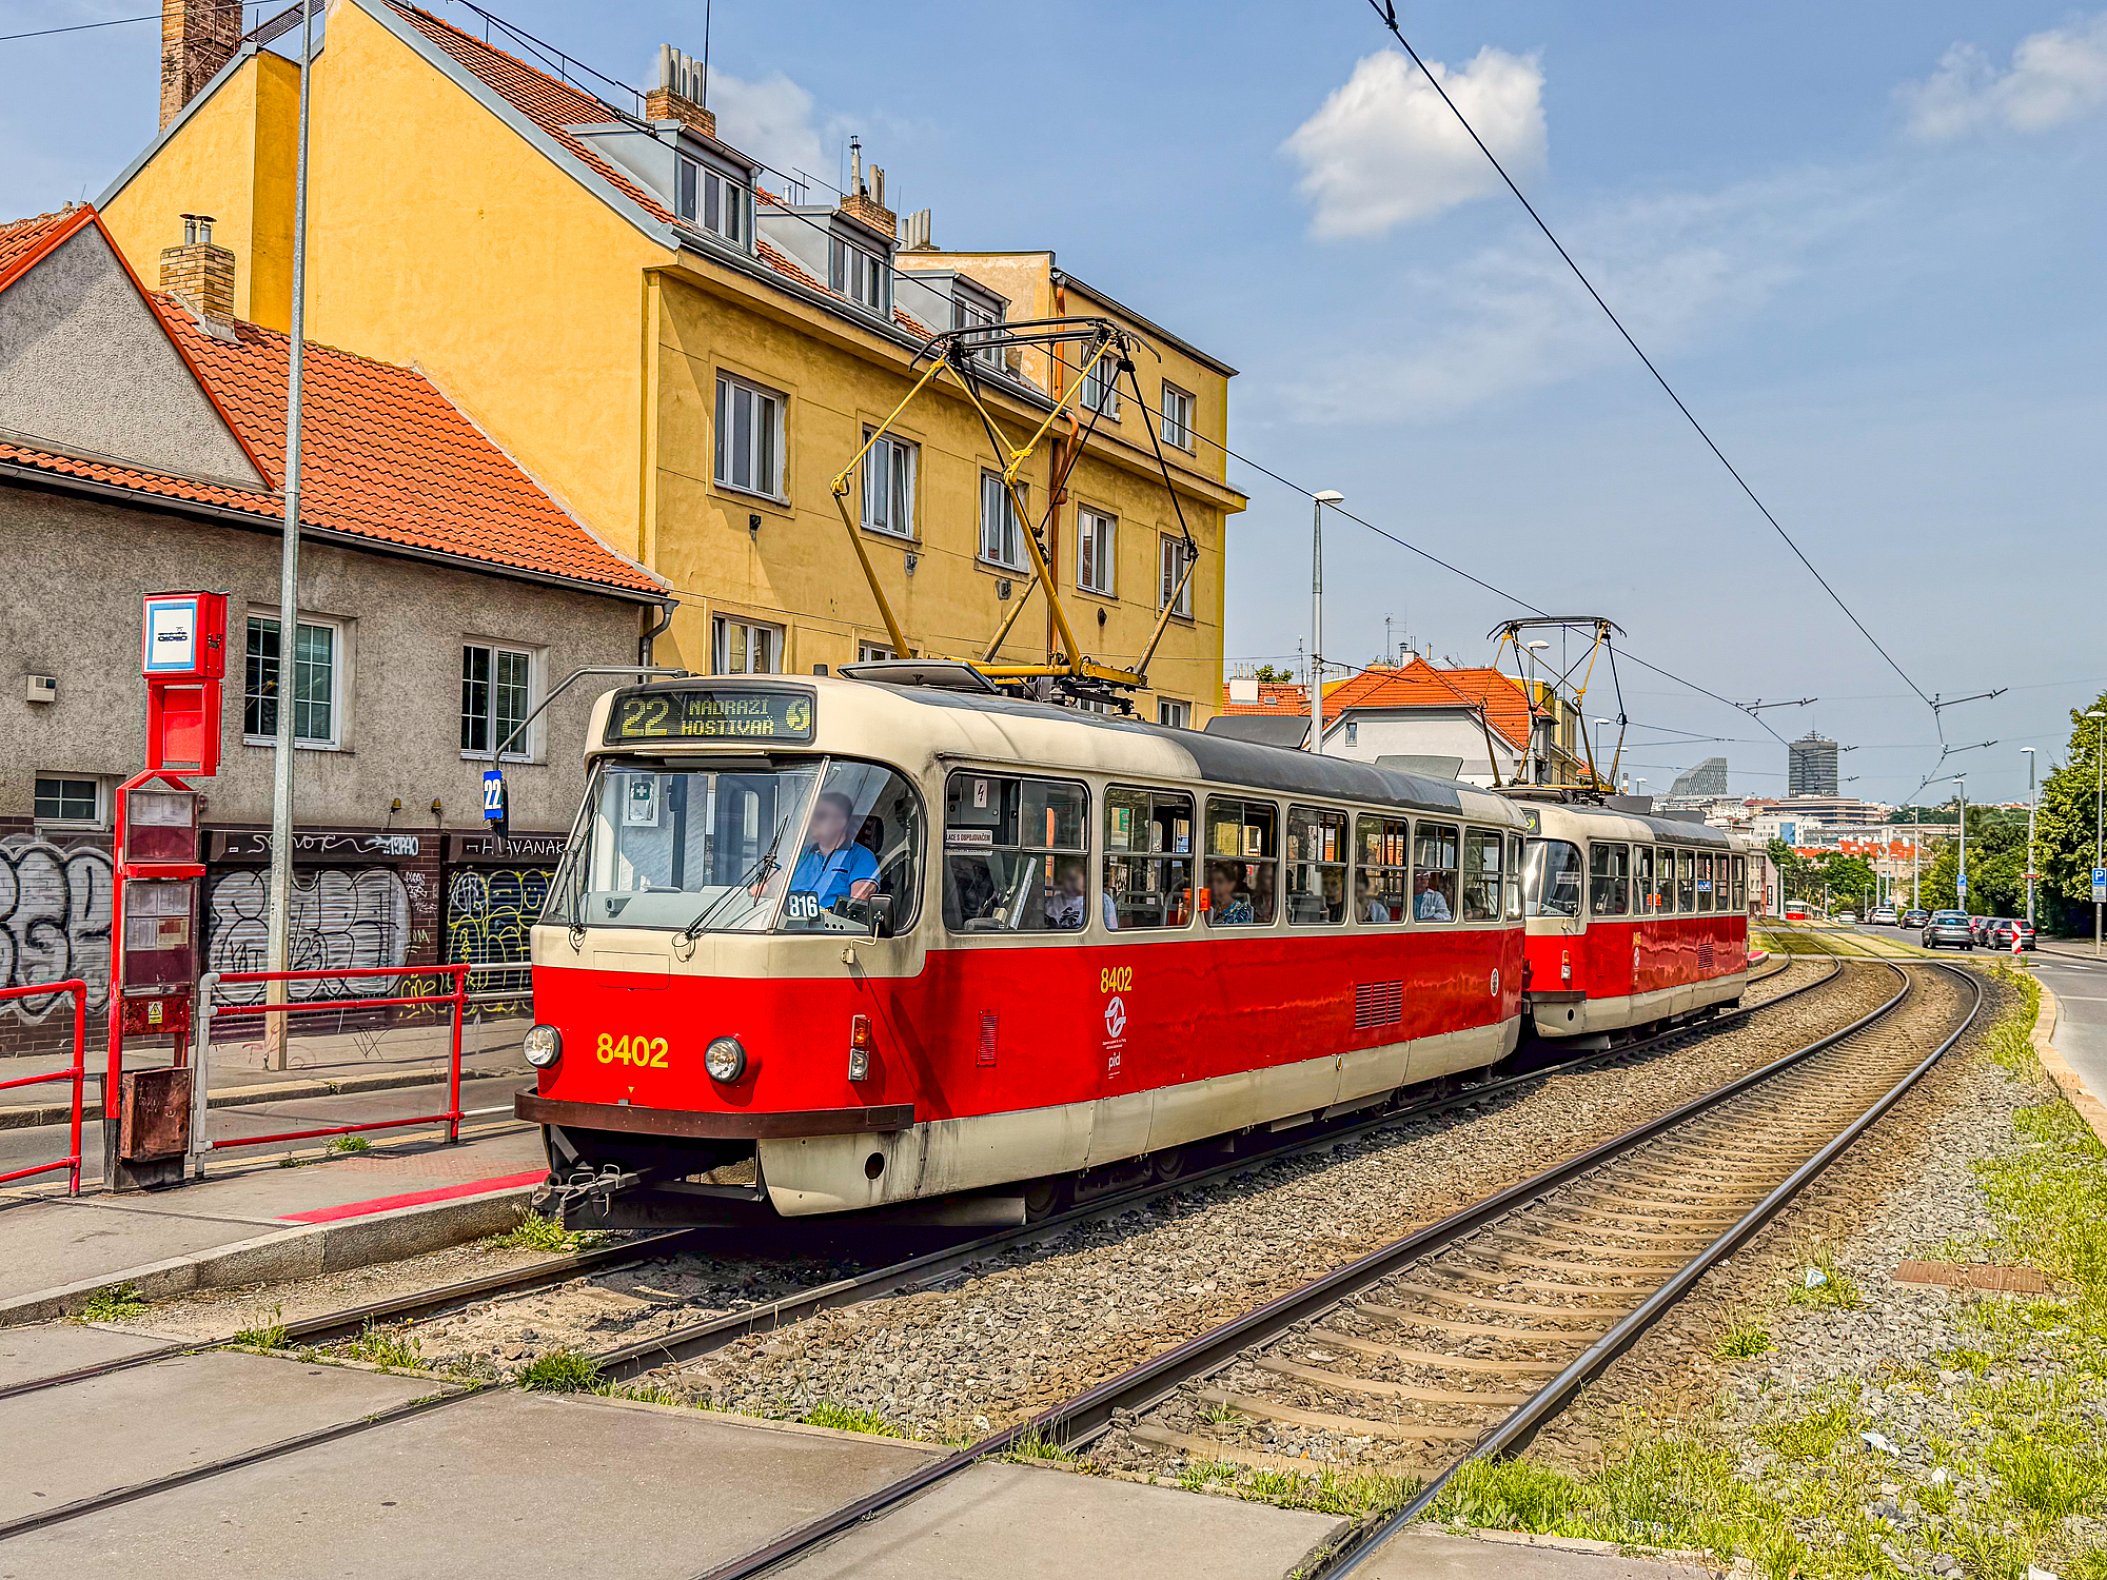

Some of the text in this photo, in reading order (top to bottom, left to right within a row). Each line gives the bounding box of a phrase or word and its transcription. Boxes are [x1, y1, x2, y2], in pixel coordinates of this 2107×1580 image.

[689, 695, 769, 715] NÁDRAŽÍ
[621, 698, 669, 736] 22
[681, 715, 774, 735] HOSTIVAŘ
[484, 779, 501, 809] 22
[2095, 871, 2103, 880] P
[788, 895, 818, 917] 816
[1101, 966, 1132, 993] 8402
[597, 1032, 669, 1069] 8402
[1108, 1052, 1121, 1071] pid
